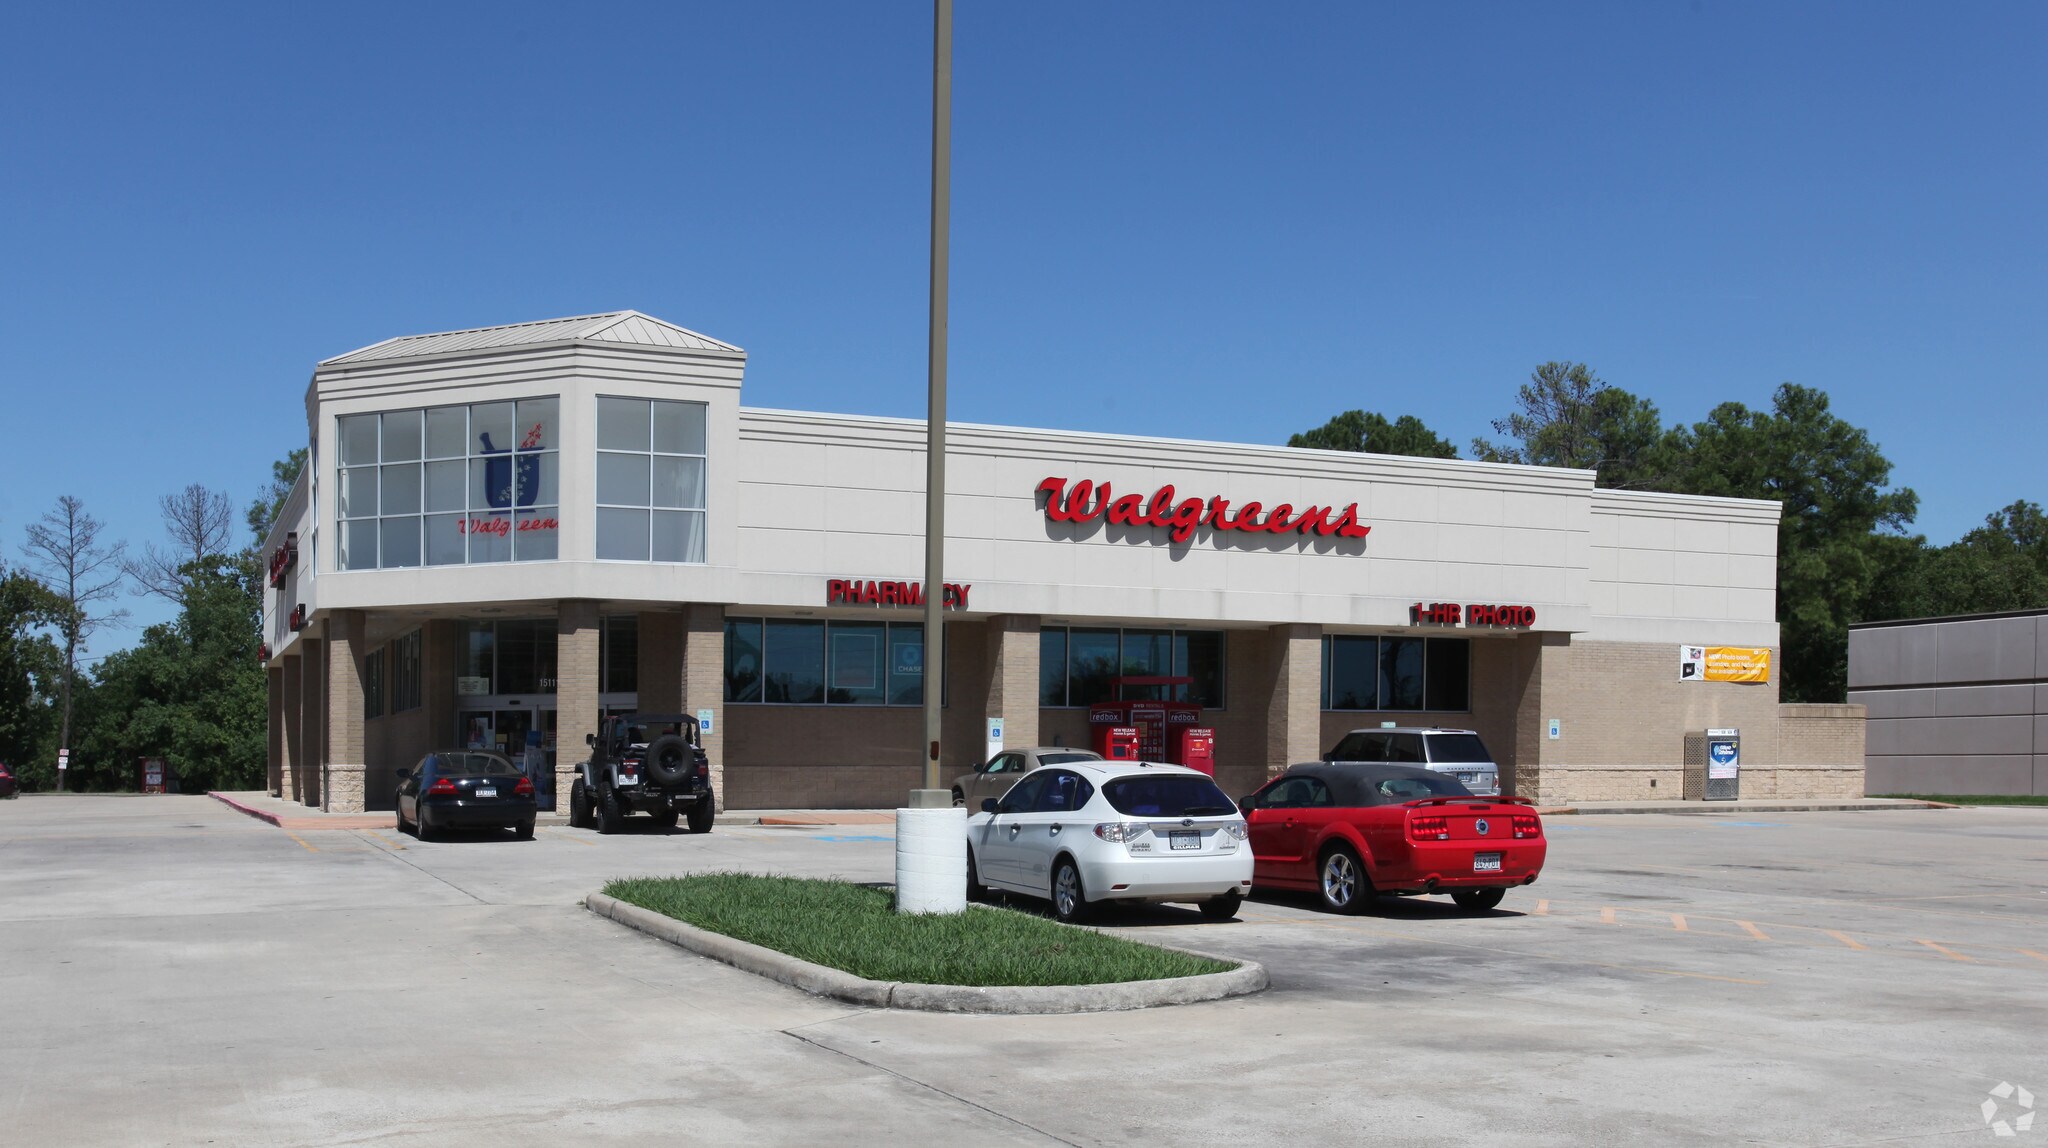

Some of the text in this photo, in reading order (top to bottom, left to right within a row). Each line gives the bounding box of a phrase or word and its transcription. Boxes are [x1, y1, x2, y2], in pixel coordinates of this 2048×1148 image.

[1035, 477, 1371, 543] Walgreens
[458, 518, 558, 536] Walgeen
[1413, 602, 1536, 626] 1-HR PHOTO
